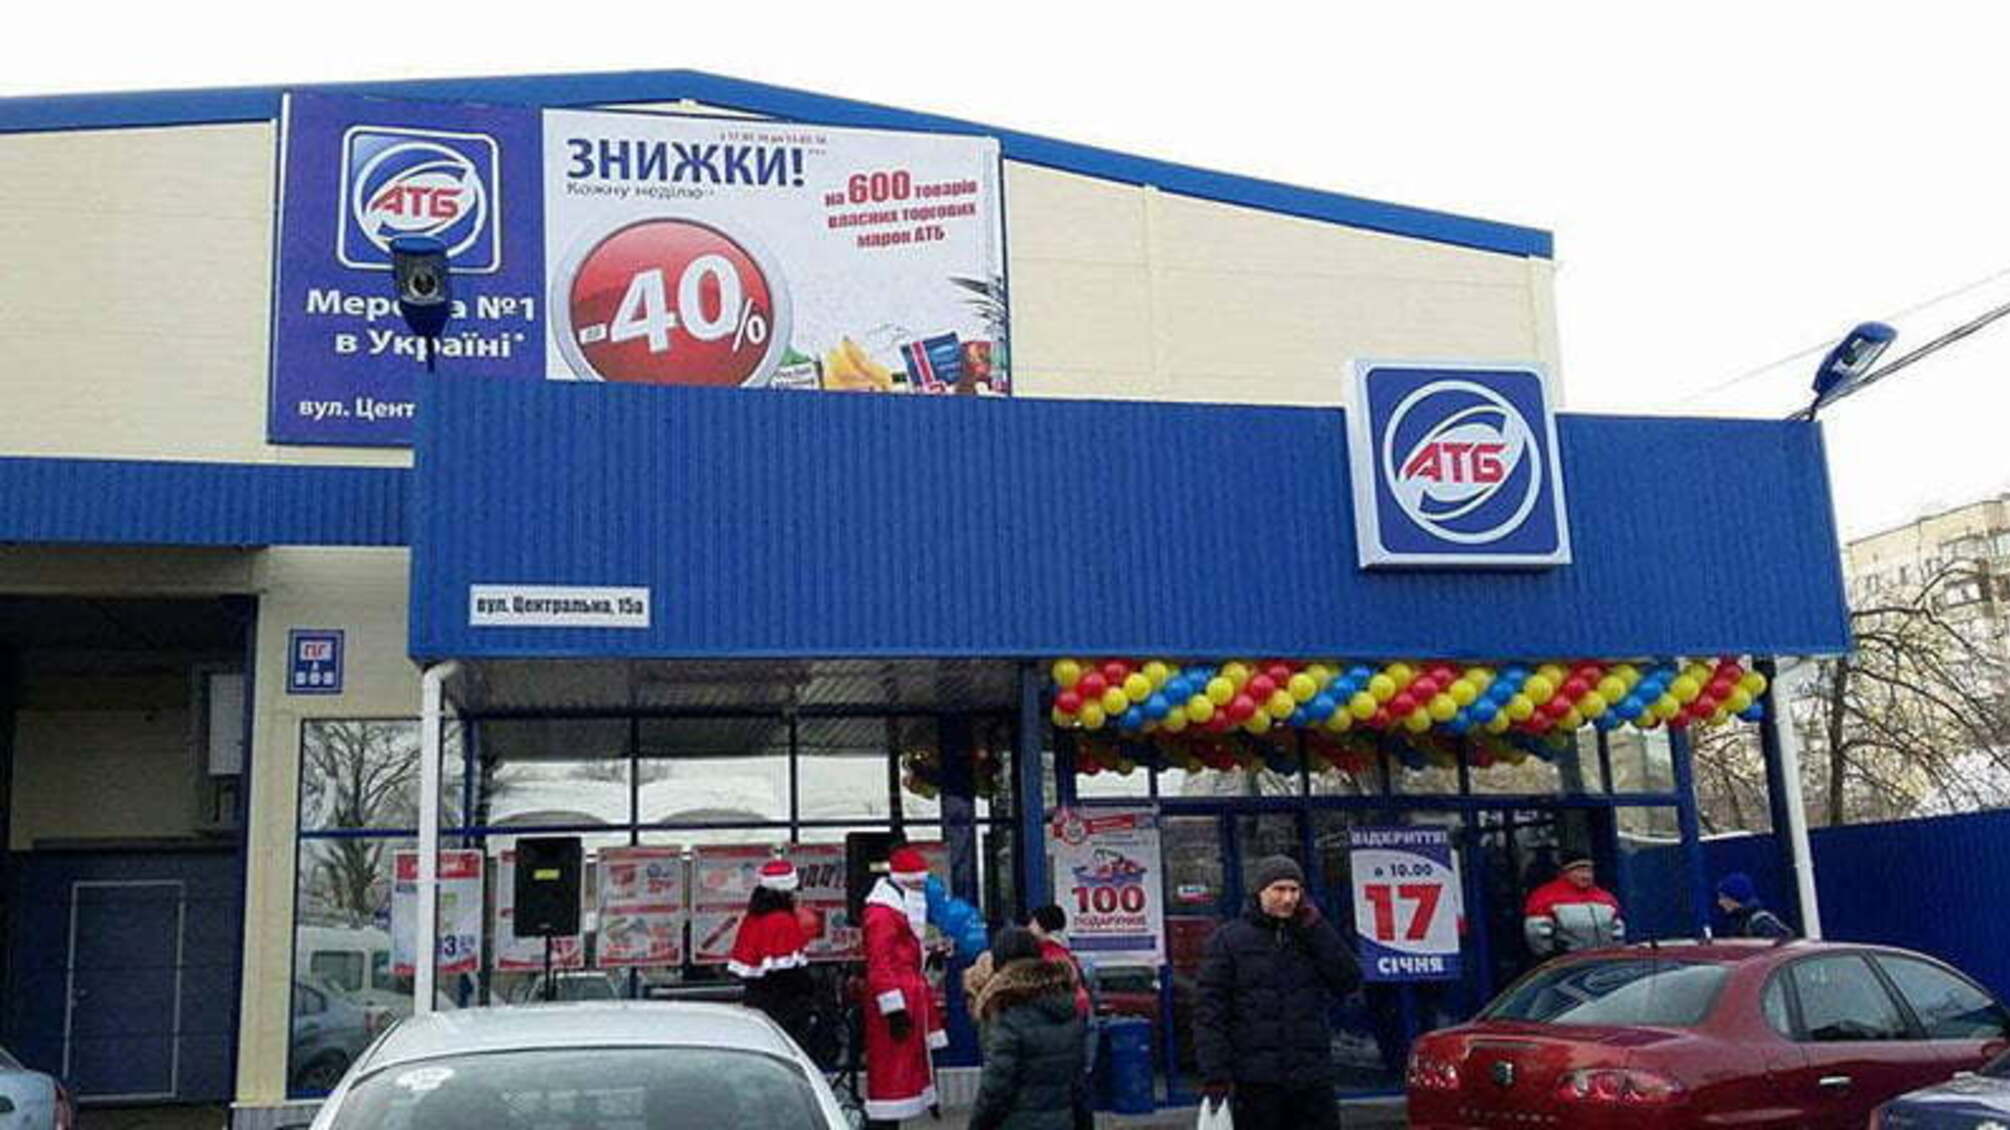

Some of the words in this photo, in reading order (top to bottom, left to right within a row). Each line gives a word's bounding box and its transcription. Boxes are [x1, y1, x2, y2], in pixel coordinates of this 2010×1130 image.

[567, 138, 804, 187] ЗНИЖКИ!
[371, 186, 465, 218] АТБ
[566, 183, 631, 199] Кожну
[825, 192, 845, 207] на
[848, 170, 911, 203] 600
[915, 180, 977, 198] товарів
[828, 210, 899, 229] власних
[902, 203, 977, 222] торгових
[857, 230, 912, 248] марок
[914, 225, 945, 243] АТБ
[306, 288, 467, 322] Мера
[476, 296, 534, 321] №1
[579, 253, 767, 352] -40%
[335, 333, 358, 353] в
[298, 400, 350, 421] вул.
[1404, 442, 1507, 483] АТБ
[476, 597, 508, 615] вул.
[512, 596, 614, 615] Центральна,
[618, 597, 644, 615] 15а
[1390, 863, 1434, 877] 10.00
[1071, 885, 1147, 914] 100
[1364, 883, 1444, 941] 17
[1377, 956, 1445, 974] СІЧНЯ
